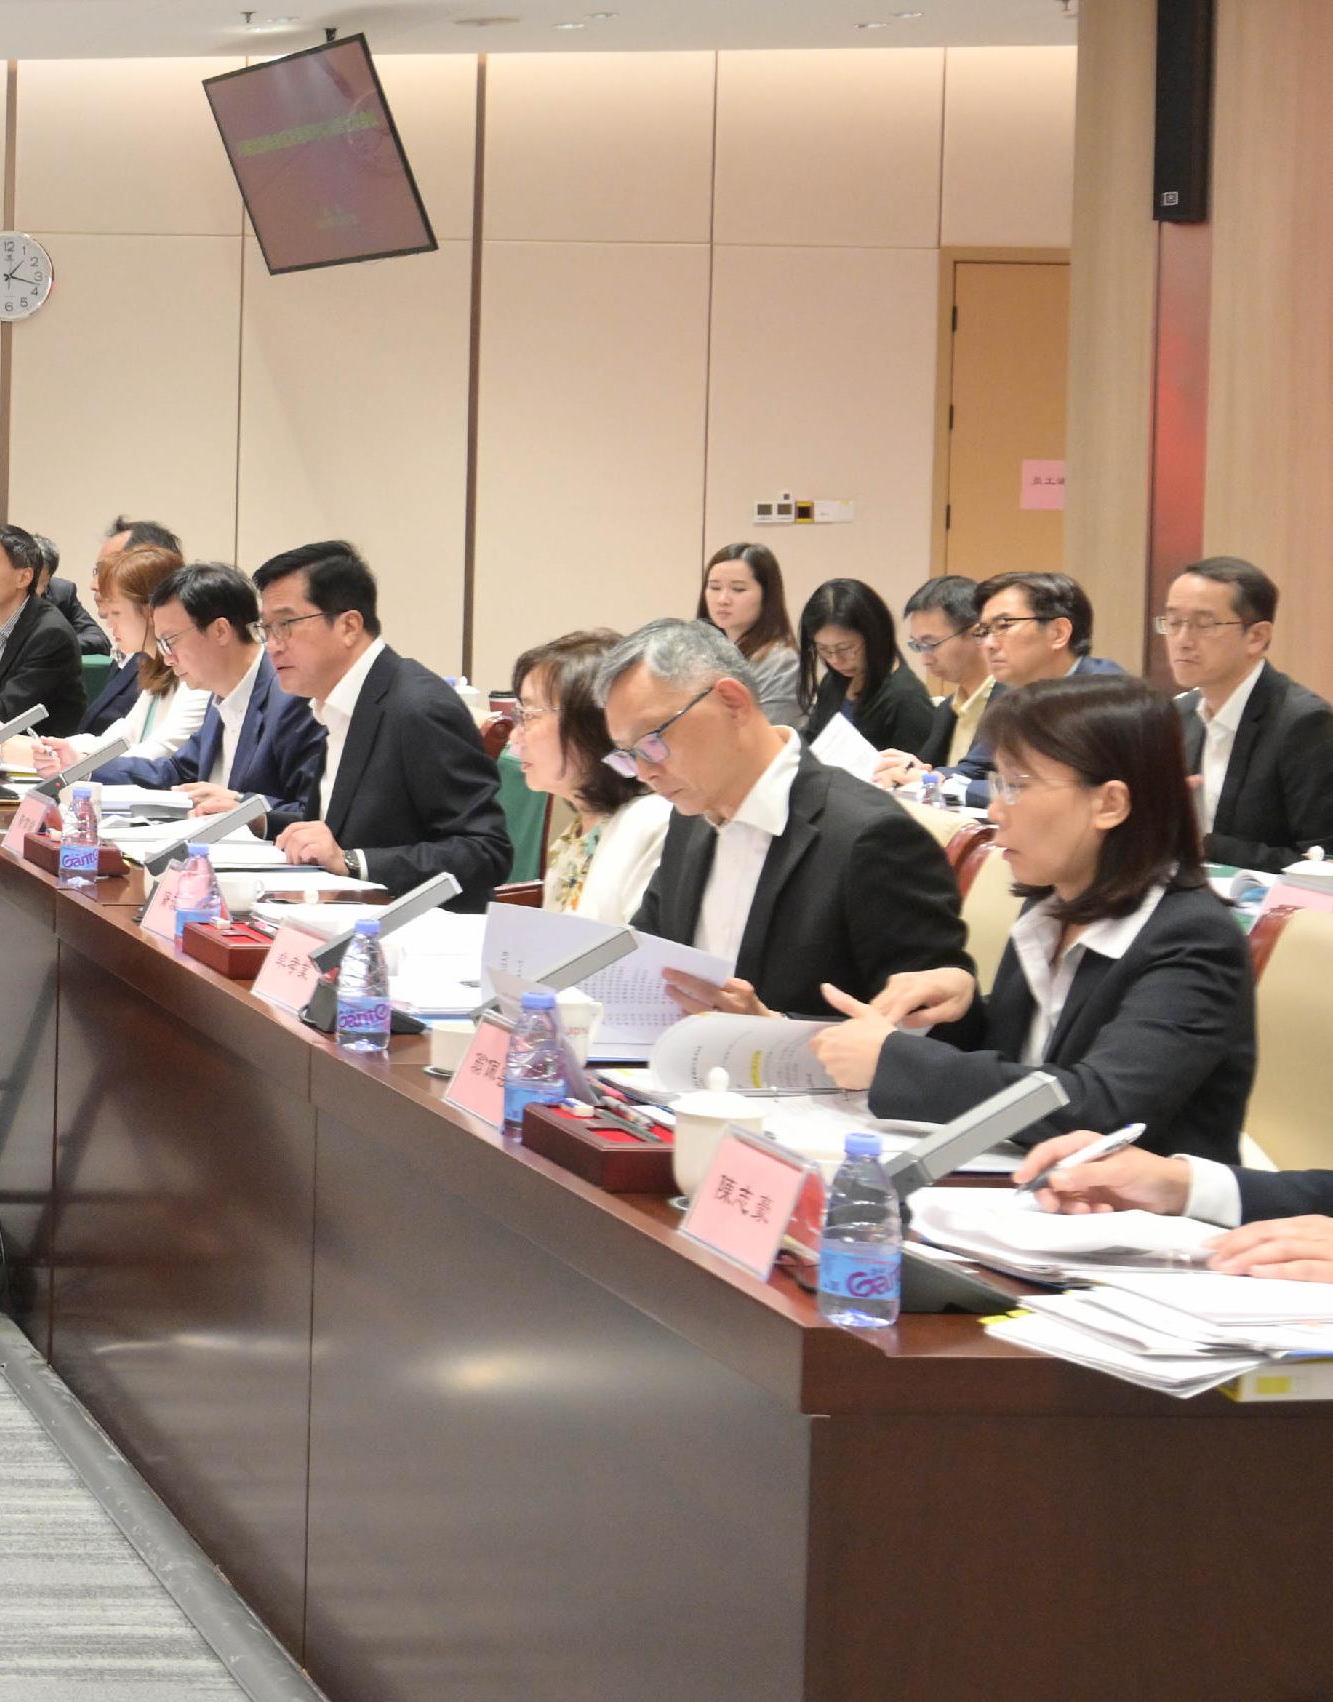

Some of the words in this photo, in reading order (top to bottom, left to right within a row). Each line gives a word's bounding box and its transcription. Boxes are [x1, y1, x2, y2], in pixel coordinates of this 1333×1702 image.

[4, 241, 15, 252] 12
[30, 256, 39, 267] 2
[34, 271, 43, 282] 3
[30, 286, 39, 296] 4
[4, 301, 14, 312] 6
[20, 296, 29, 308] 5
